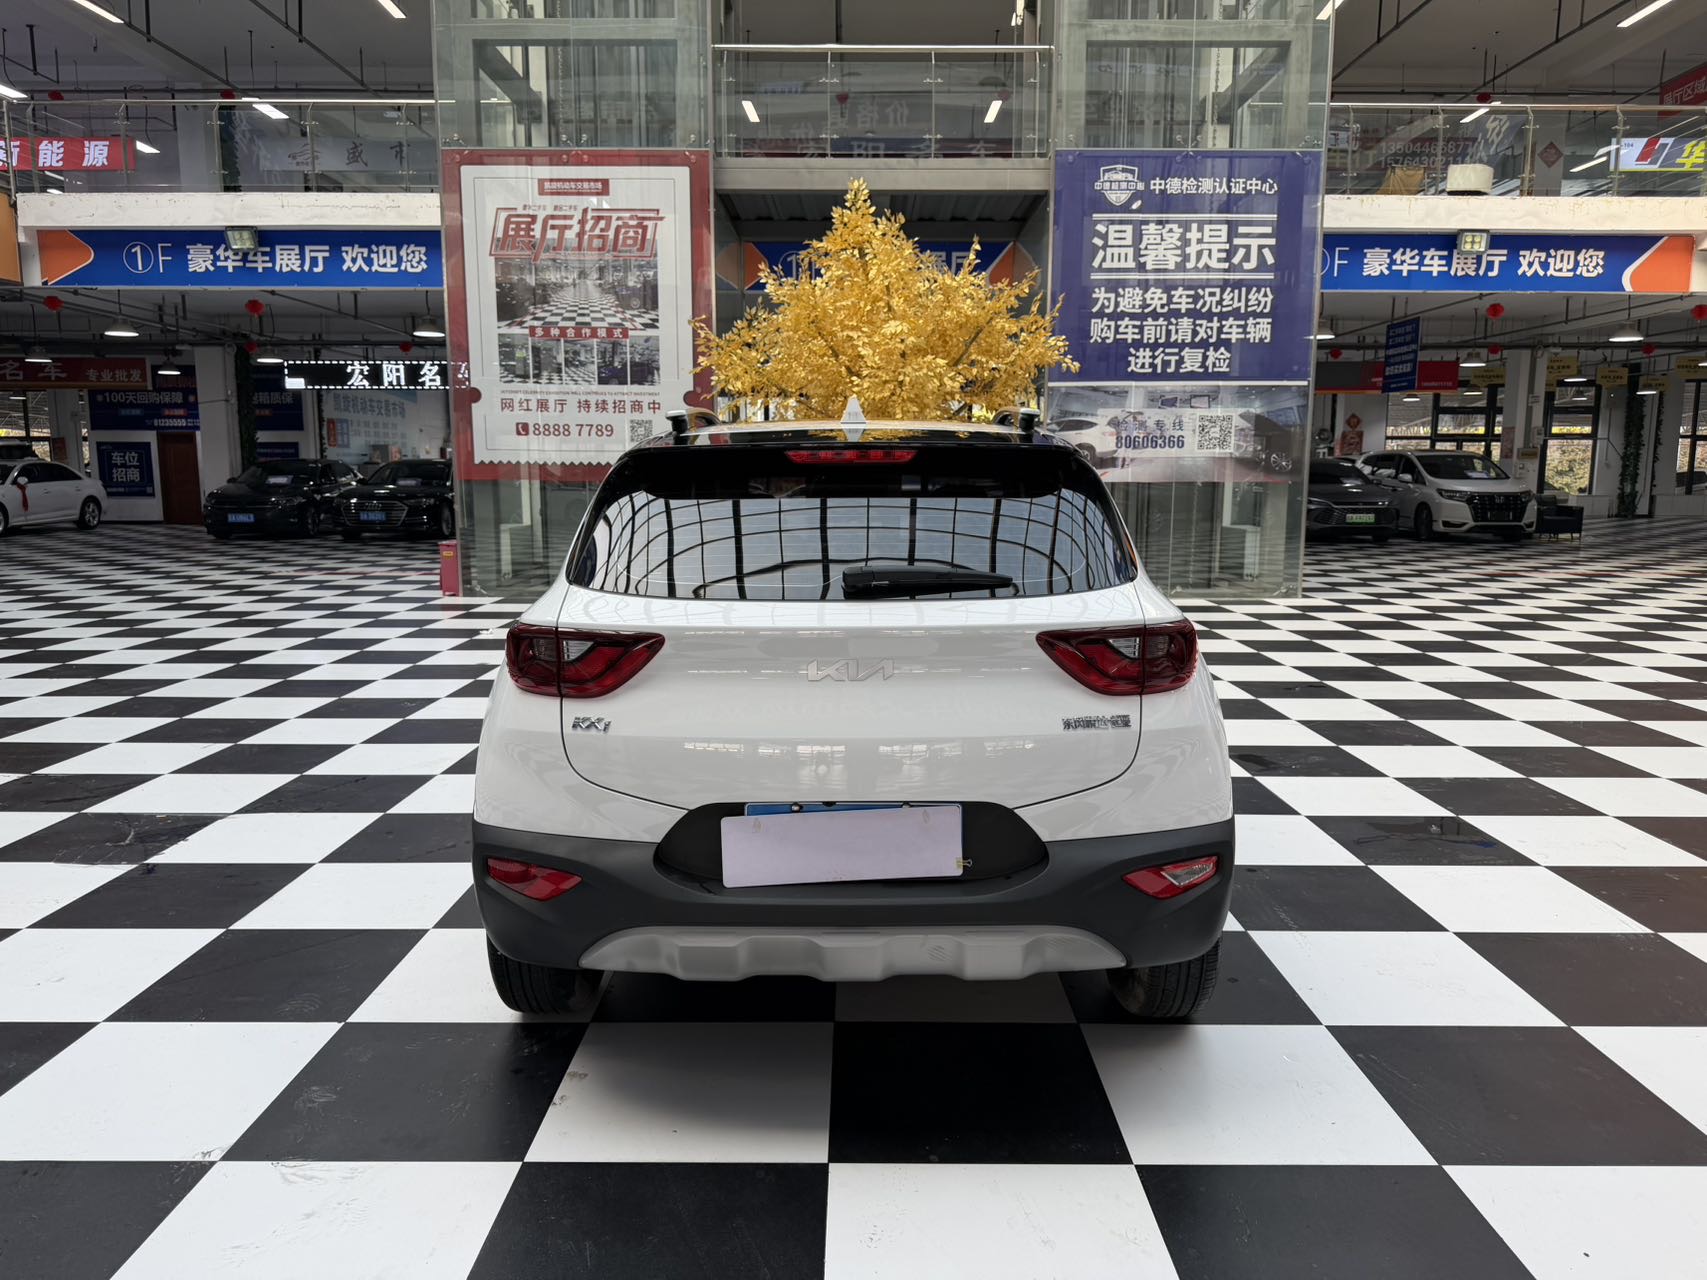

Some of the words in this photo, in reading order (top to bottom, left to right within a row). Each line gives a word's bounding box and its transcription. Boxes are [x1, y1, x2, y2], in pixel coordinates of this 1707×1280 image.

[1150, 177, 1278, 195] 中德检测认证中心
[500, 206, 666, 263] 展厅招商
[1091, 223, 1277, 270] 温馨提示
[186, 243, 331, 273] 豪华车展厅
[342, 243, 429, 274] 欢迎您
[1362, 247, 1508, 278] 豪华车展厅
[1518, 248, 1606, 278] 欢迎您
[1091, 286, 1274, 314] 为避免车况纠纷
[534, 327, 624, 338] 多种合作模式
[1089, 316, 1273, 344] 购车前请对车辆
[1127, 347, 1231, 373] 进行复检
[85, 368, 142, 382] 专业批发
[501, 398, 568, 413] 网红展厅
[577, 398, 662, 415] 持续招商中
[532, 422, 571, 437] 8888
[576, 423, 614, 438] 7789
[1115, 434, 1185, 449] 80606366
[111, 451, 140, 466] 车位
[112, 467, 140, 482] 招商
[807, 658, 895, 682] KIA
